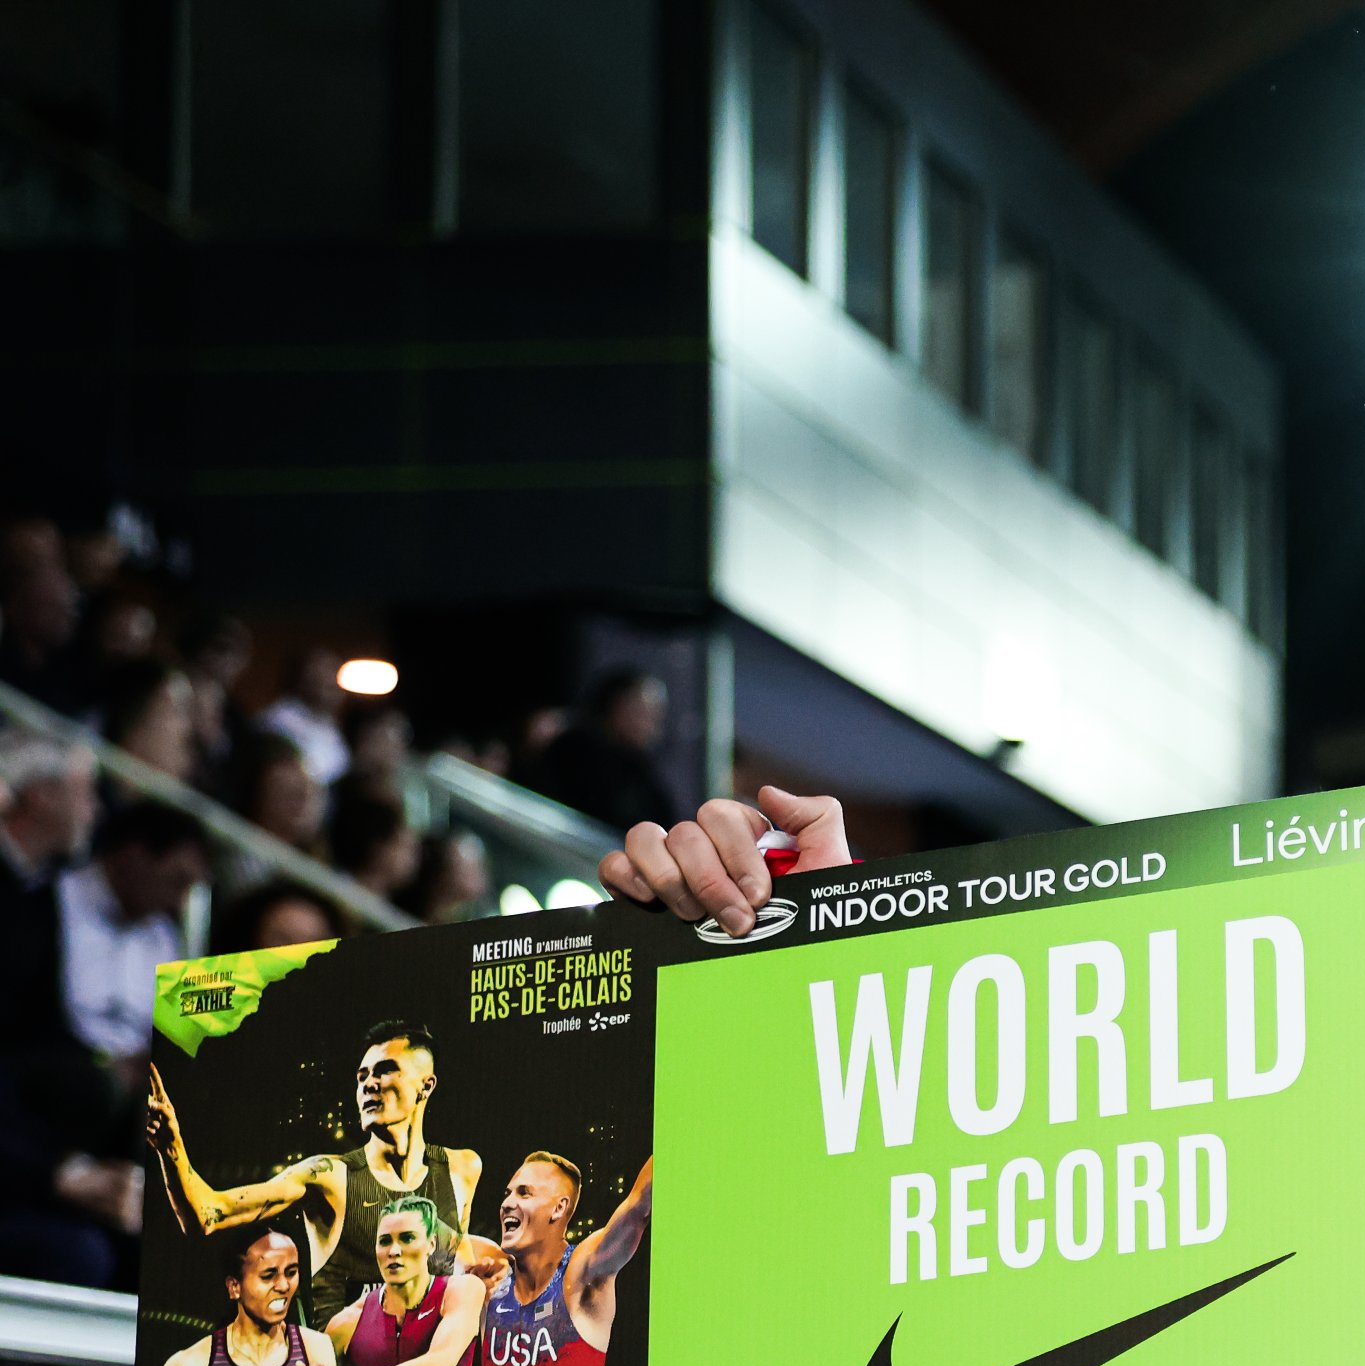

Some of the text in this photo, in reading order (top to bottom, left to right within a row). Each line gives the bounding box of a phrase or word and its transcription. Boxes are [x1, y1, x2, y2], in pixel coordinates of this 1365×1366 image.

[809, 852, 1167, 933] INDOOR TOUR GOLD
[811, 869, 932, 900] WORLD ATHLETICS
[471, 948, 633, 994] HAUTS-DE-FRANCE
[472, 934, 593, 963] MEETING D'ATHLÉTISME
[219, 970, 233, 982] par
[470, 973, 632, 1023] PAS-DE-CALAIS
[542, 1016, 582, 1034] Trophée
[808, 914, 1308, 1156] WORLD
[889, 1132, 1229, 1286] RECORD
